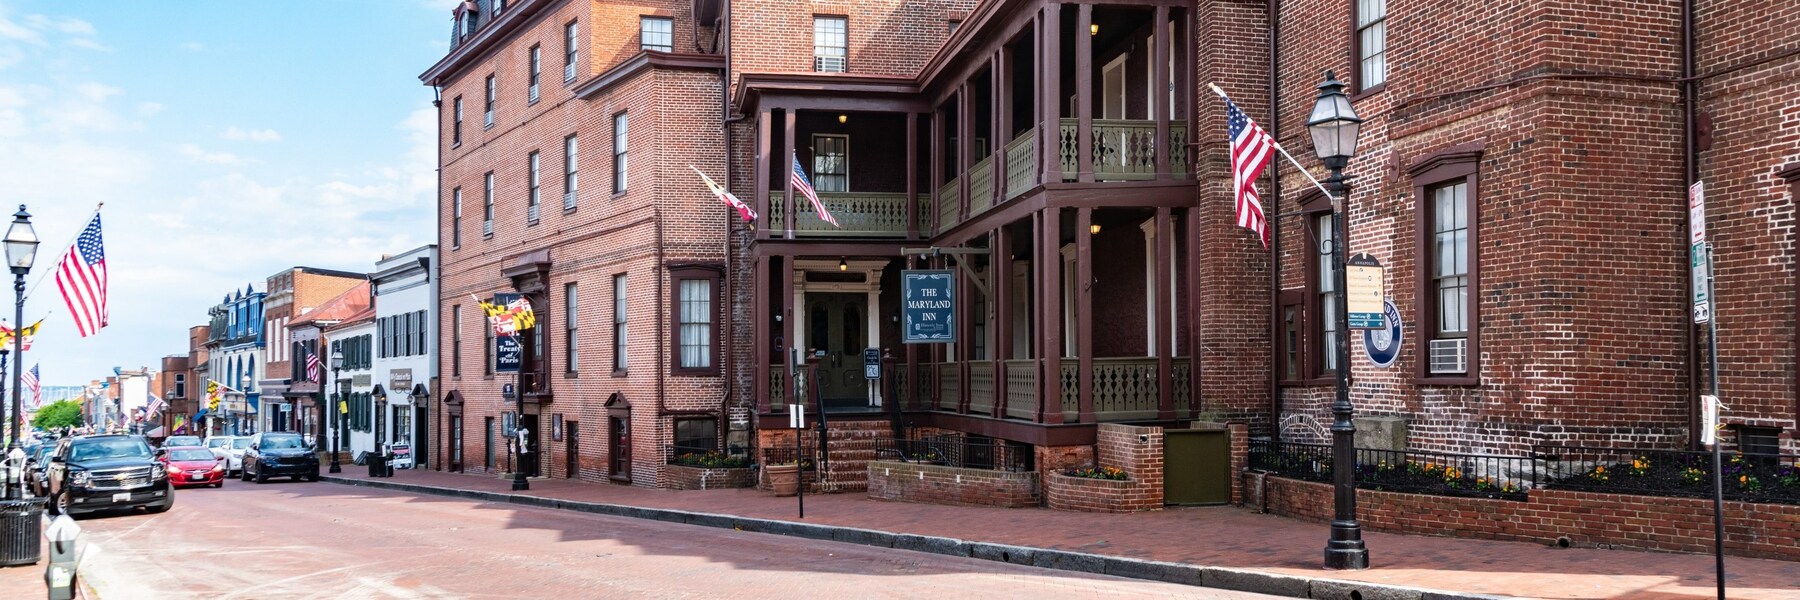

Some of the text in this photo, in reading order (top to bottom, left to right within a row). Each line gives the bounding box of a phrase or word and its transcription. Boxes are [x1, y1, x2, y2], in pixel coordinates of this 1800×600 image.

[920, 288, 938, 297] THE
[908, 300, 951, 309] MARYLAND
[922, 312, 937, 321] INN
[1389, 310, 1400, 328] INN
[499, 356, 519, 364] Paris
